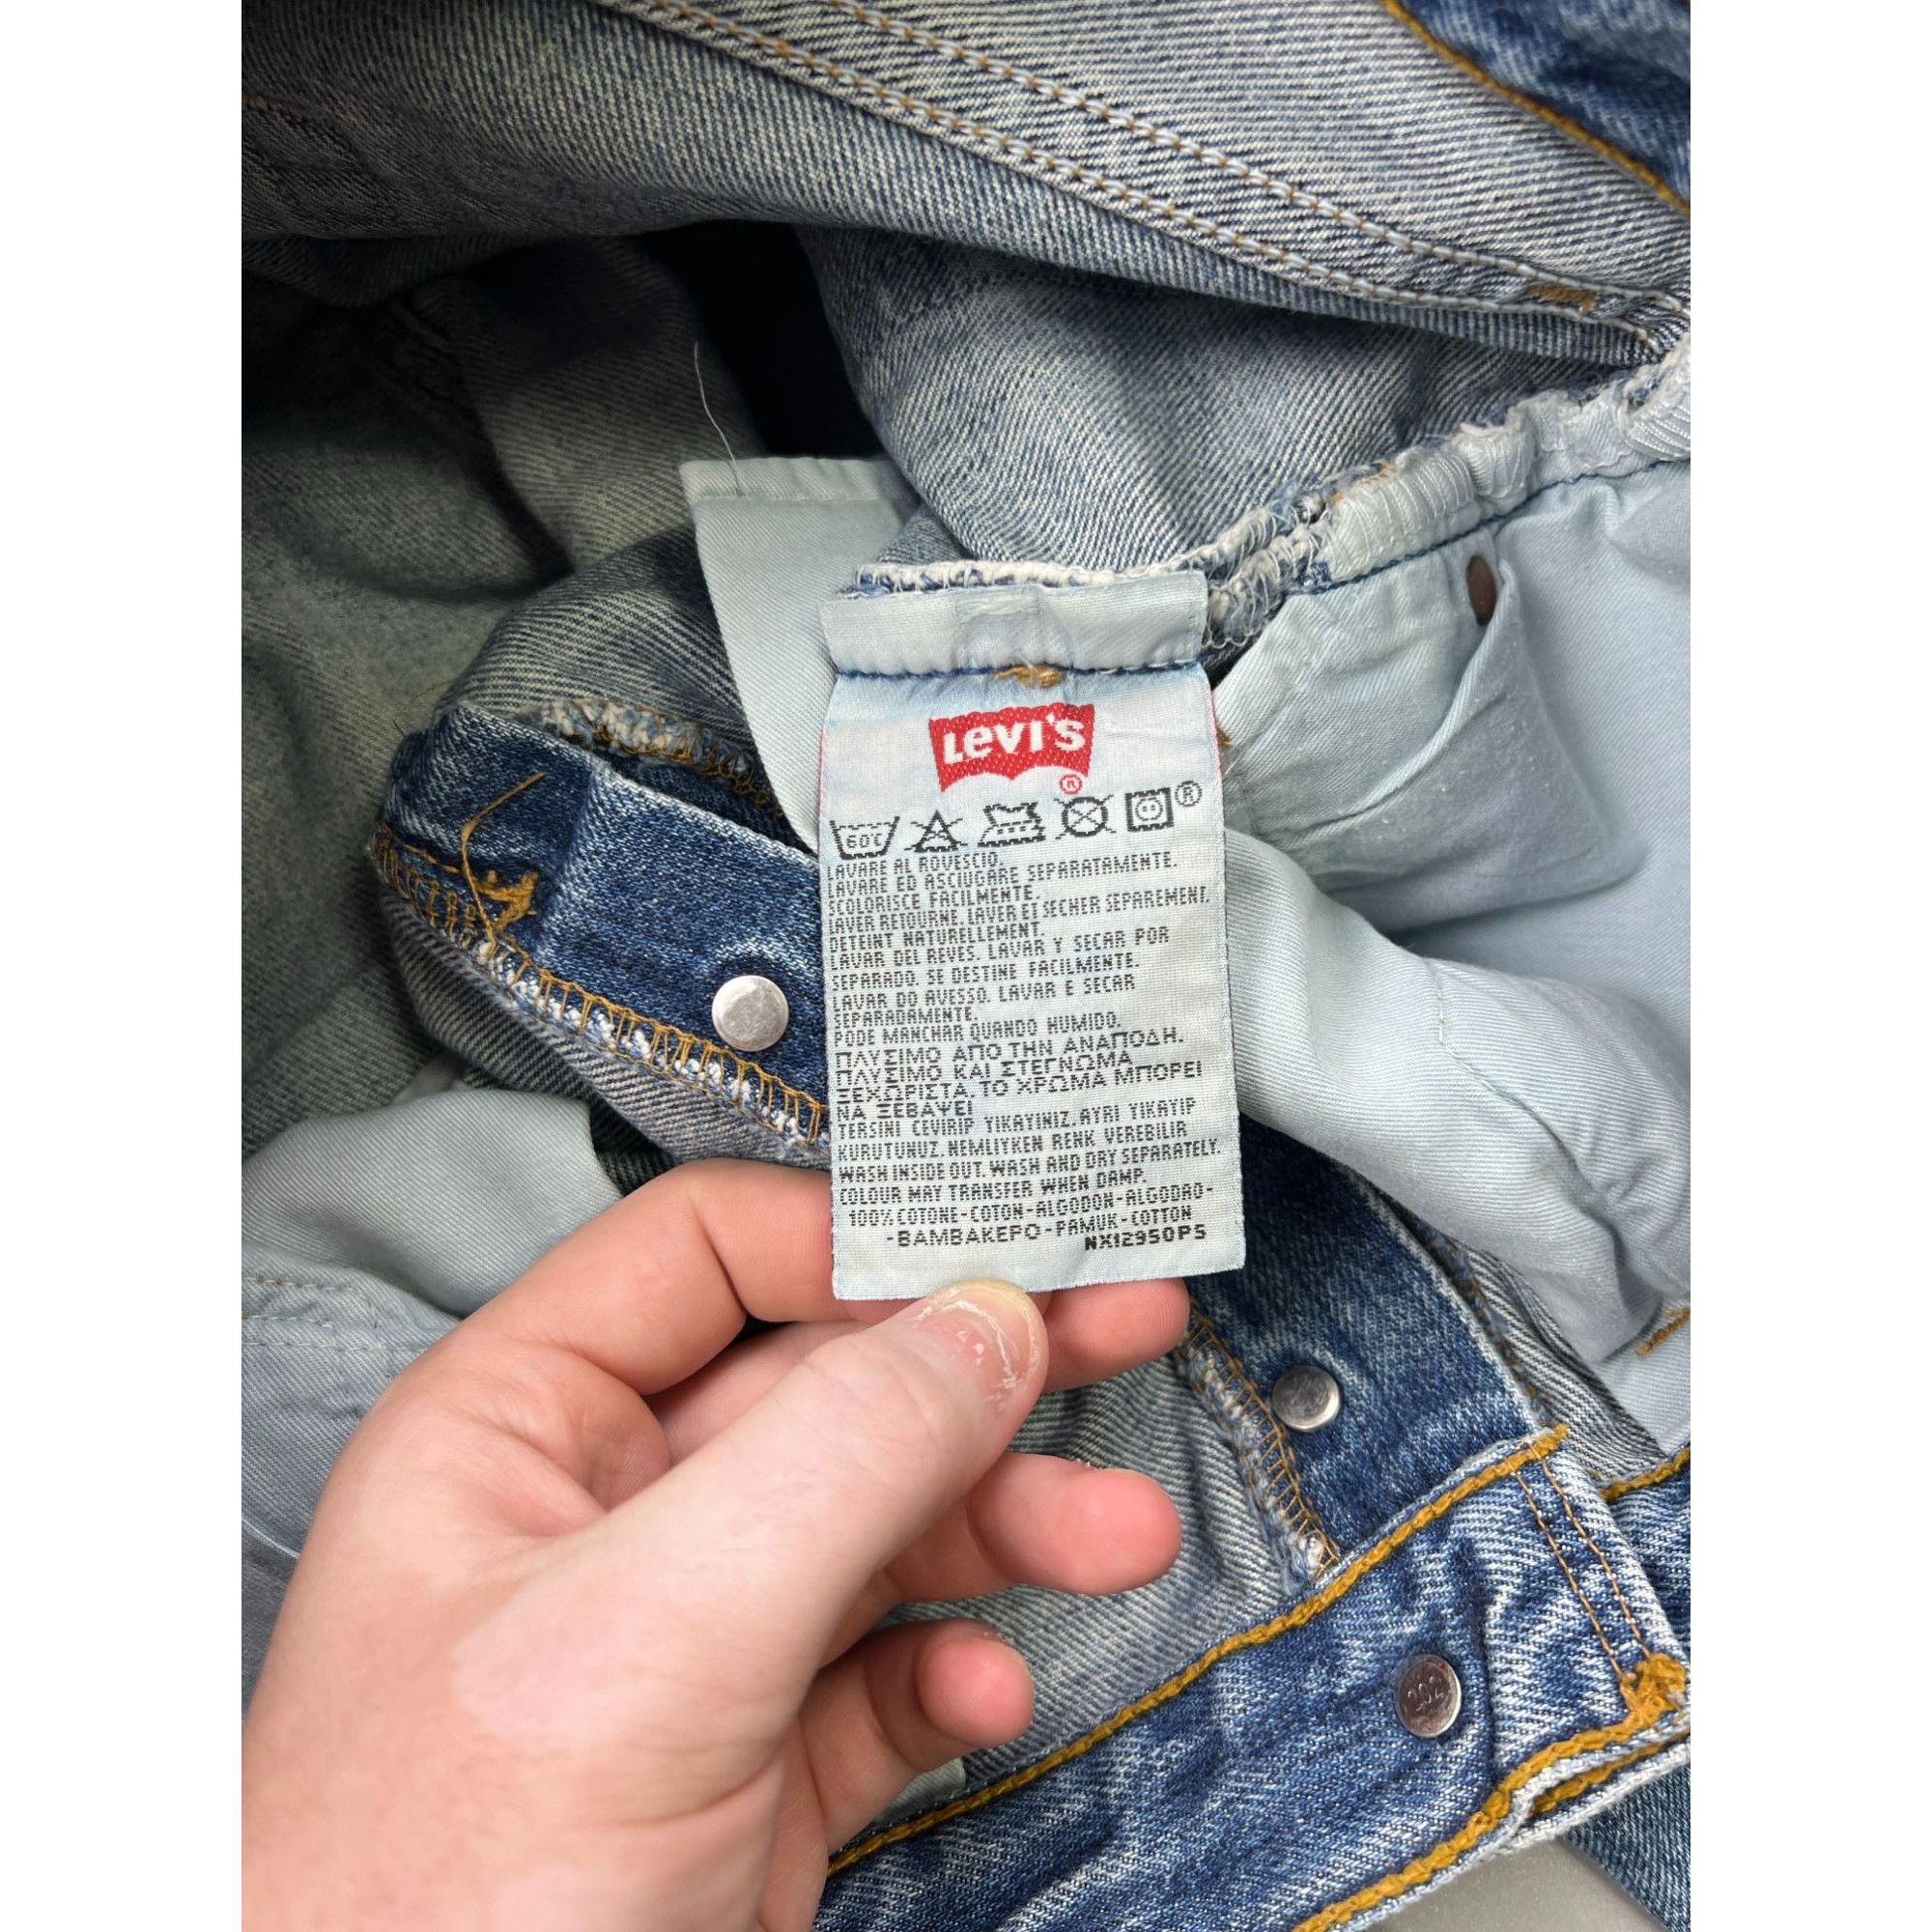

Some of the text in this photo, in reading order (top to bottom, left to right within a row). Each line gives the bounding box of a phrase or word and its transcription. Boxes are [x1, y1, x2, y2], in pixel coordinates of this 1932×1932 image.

[827, 851, 1005, 881] LAVARE AL ROVESCIO.
[828, 851, 1178, 898] LAVARE ED ASCIUGARE SEPARATAMENTE.
[828, 894, 921, 917] SCOLORISCE
[828, 916, 875, 935] LAVER
[879, 908, 964, 932] RETOURNE.
[967, 903, 1016, 925] LAVER
[1042, 895, 1101, 918] SECHER
[829, 921, 1045, 953] DETEINT NATURELLEMENT.
[831, 925, 1170, 971] LAVAR DEL REVES. LAVAR Y SECAR POR
[832, 970, 920, 991] SEPARADO.
[927, 968, 944, 985] SE
[951, 963, 1017, 983] DESTINE
[833, 974, 1136, 1012] LAVAR DO AVESSO. LAVAR E SECAR
[834, 1006, 979, 1029] SEPARADAMENTE.
[834, 1010, 1122, 1047] PODE MANCHAR QUANDO HUMIDO.
[838, 1121, 901, 1140] TERSINI
[912, 1117, 975, 1136] CEVIRIP
[1079, 1104, 1120, 1125] AYRI
[838, 1121, 1188, 1162] KURUTUNUZ. NEMLIYKEN RENK VEREBILIR
[838, 1138, 1221, 1182] WASH INSIDE OUT. WASH AND DRY SEPARATELY.
[839, 1168, 1147, 1205] COLOUR MAY TRANSFER WHEN DAMP.
